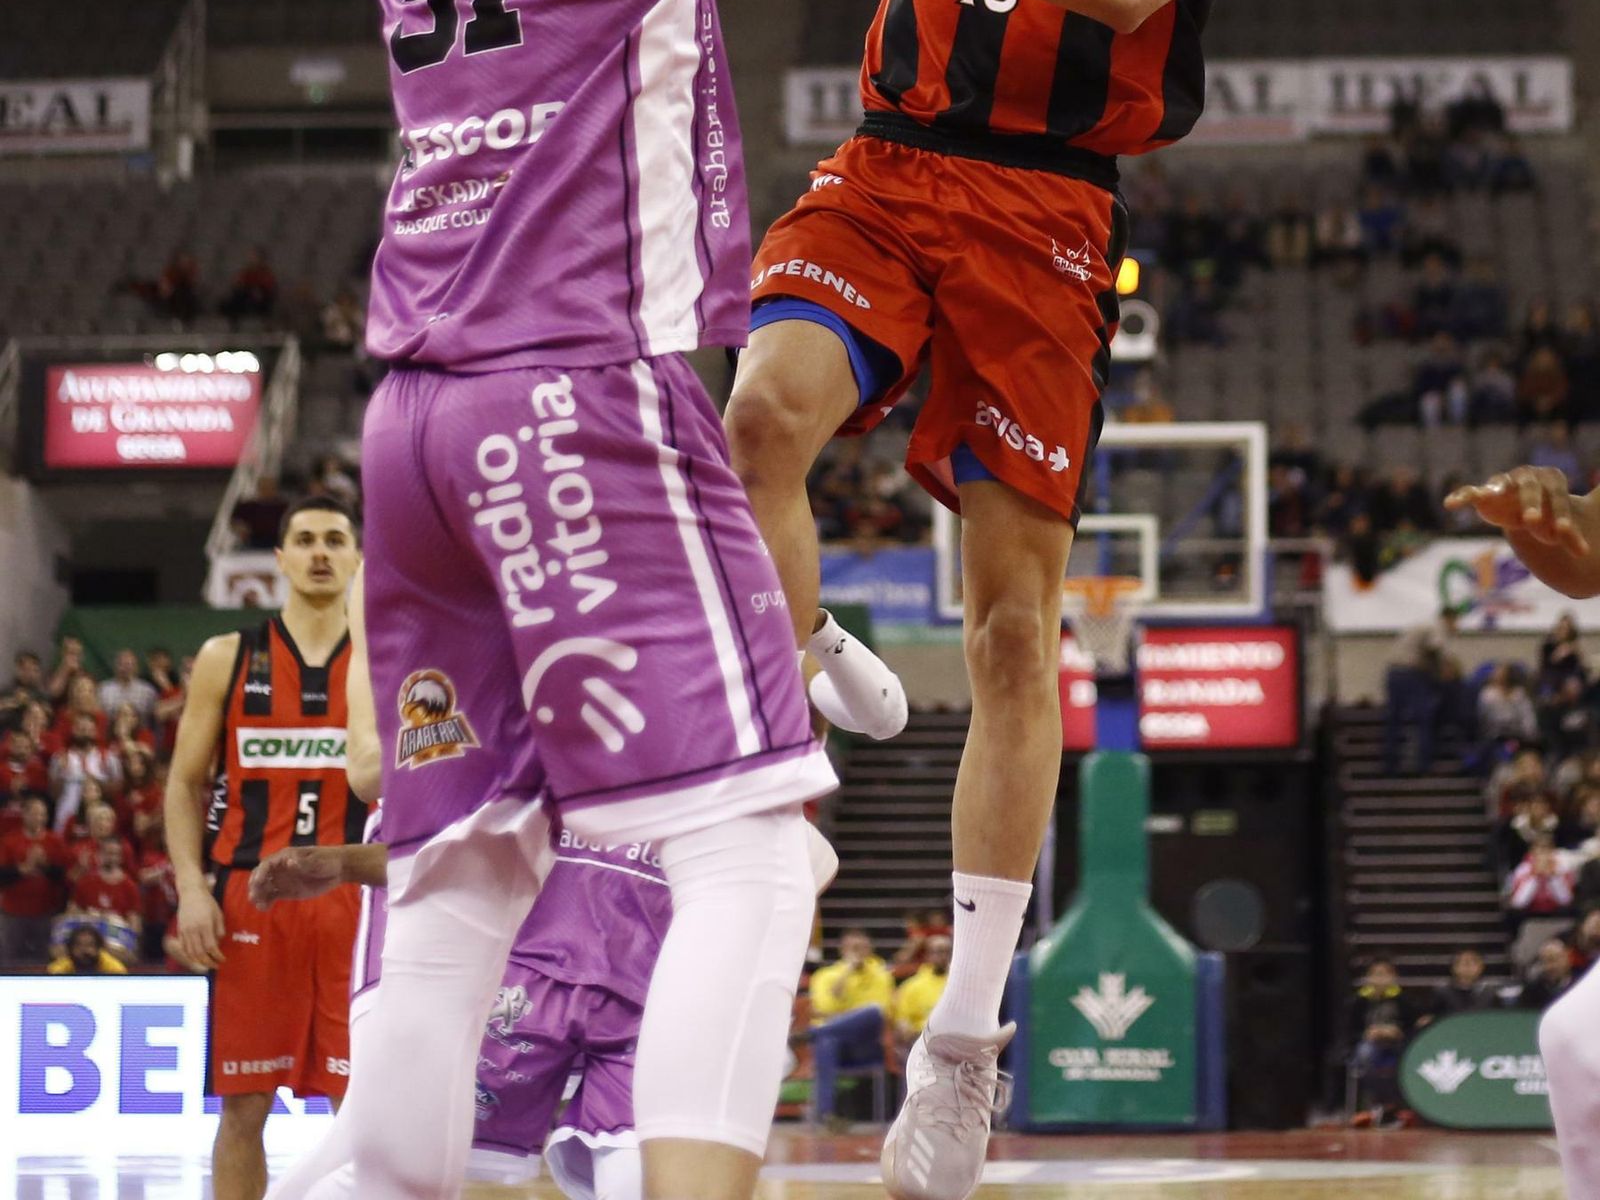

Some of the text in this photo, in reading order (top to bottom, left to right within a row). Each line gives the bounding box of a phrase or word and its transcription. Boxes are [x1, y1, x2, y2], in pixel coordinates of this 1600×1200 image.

[393, 213, 448, 235] BASQUE
[467, 433, 556, 629] radio
[517, 373, 619, 616] vitoria
[296, 791, 319, 836] 5
[18, 1002, 185, 1114] BE
